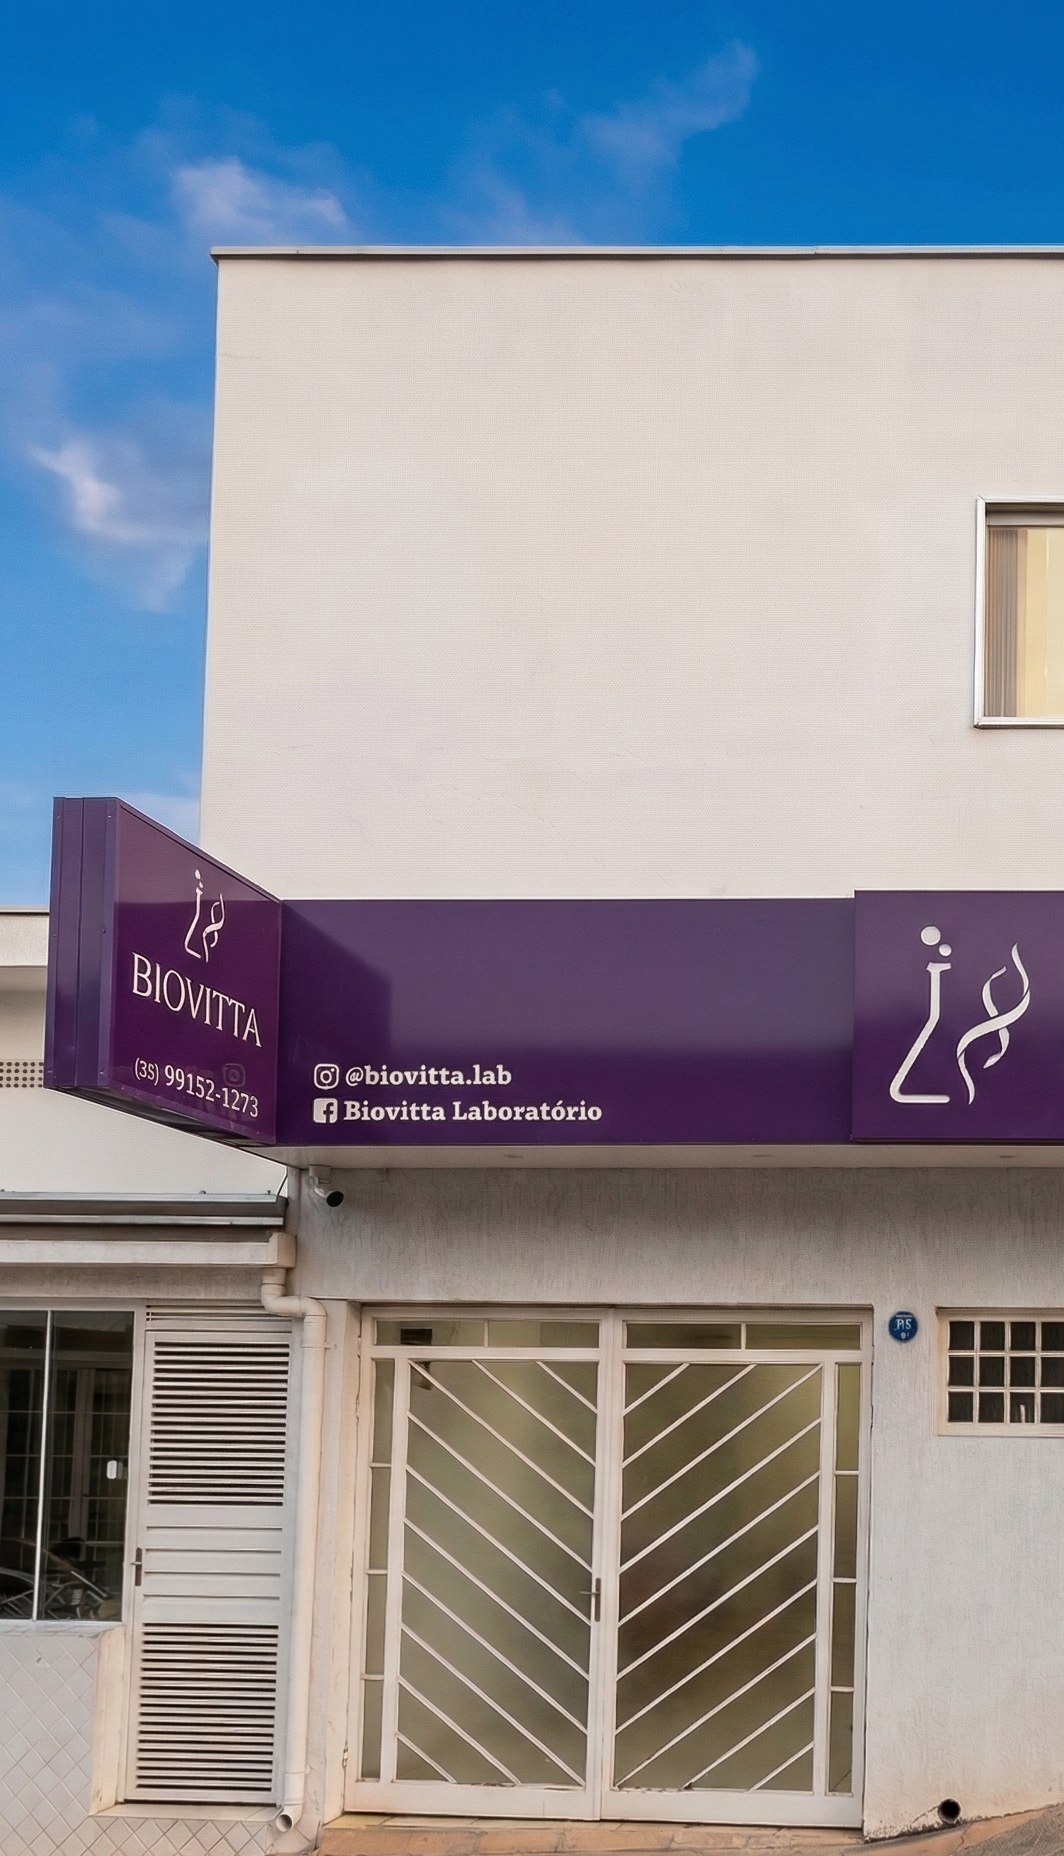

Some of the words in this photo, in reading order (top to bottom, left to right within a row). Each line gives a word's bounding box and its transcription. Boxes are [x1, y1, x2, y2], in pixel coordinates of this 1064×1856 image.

[131, 951, 262, 1048] BIOVITTA
[134, 1057, 160, 1086] (35)
[164, 1064, 259, 1118] 99152-1273
[345, 1065, 512, 1088] @biovitta.lab
[343, 1099, 447, 1122] Biovitta
[452, 1098, 603, 1122] Laboratório
